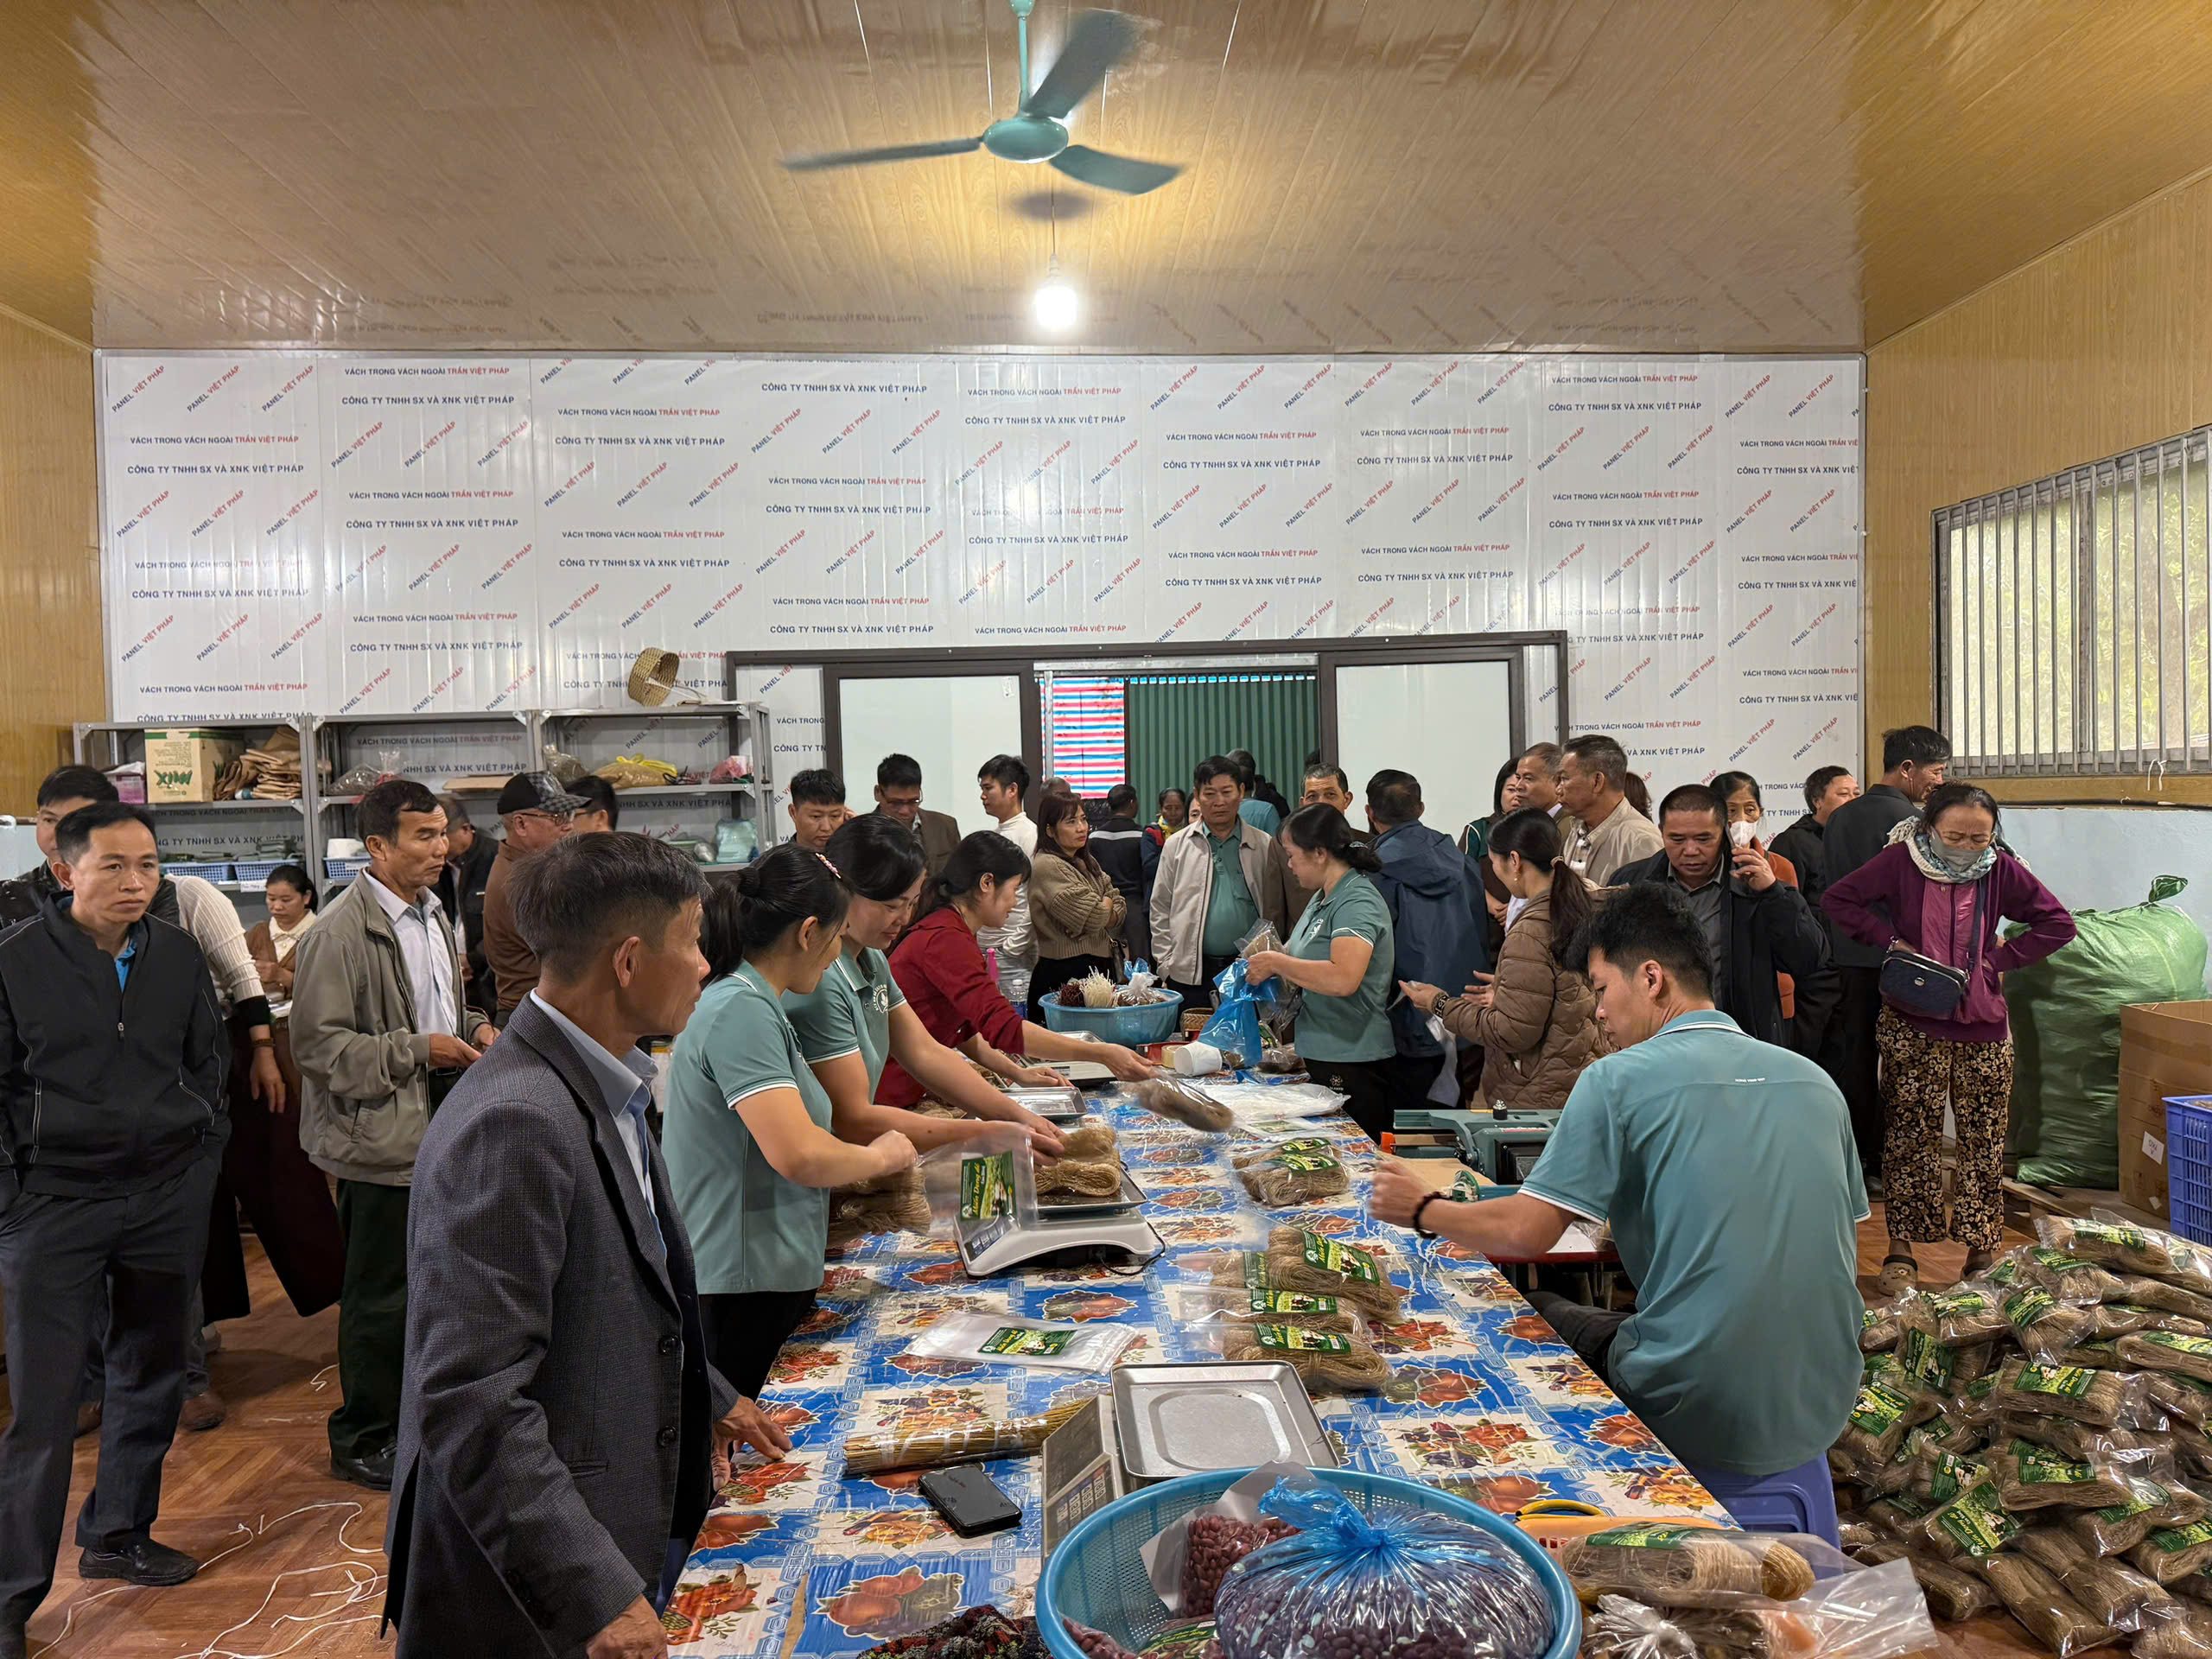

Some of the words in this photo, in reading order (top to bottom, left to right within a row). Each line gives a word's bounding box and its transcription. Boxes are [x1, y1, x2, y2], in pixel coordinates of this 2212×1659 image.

[345, 366, 365, 375] VÁCH
[421, 366, 445, 375] NGOÀI
[469, 366, 486, 375] VIỆT
[1551, 375, 1571, 384] VÁCH
[111, 394, 134, 412] PANEL
[132, 379, 147, 393] VIỆT
[147, 365, 164, 382] PHÁP
[761, 382, 787, 391] CÔNG
[843, 383, 855, 391] VÀ
[879, 384, 899, 393] VIỆT
[965, 416, 989, 424] CÔNG
[1044, 415, 1056, 423] VÀ
[1078, 415, 1098, 424] VIỆT
[1101, 415, 1125, 423] PHÁP
[331, 449, 353, 467] PANEL
[351, 435, 365, 449] VIỆT
[365, 421, 382, 438] PHÁP
[1357, 456, 1381, 465] CÔNG
[1466, 453, 1486, 463] VIỆT
[1489, 453, 1513, 461] PHÁP
[127, 464, 154, 474] CÔNG
[214, 464, 226, 473] VÀ
[252, 463, 274, 474] VIỆT
[1152, 512, 1173, 529] PANEL
[1171, 499, 1185, 512] VIỆT
[1184, 485, 1199, 500] PHÁP
[1789, 515, 1808, 532] PANEL
[1807, 502, 1820, 515] VIỆT
[1820, 489, 1834, 505] PHÁP
[346, 519, 372, 528] CÔNG
[430, 518, 442, 527] VÀ
[467, 518, 489, 527] VIỆT
[492, 518, 518, 527] PHÁP
[559, 558, 585, 567] CÔNG
[643, 558, 655, 567] VÀ
[679, 558, 701, 568] VIỆT
[1242, 576, 1253, 585] VÀ
[1275, 575, 1295, 585] VIỆT
[1298, 575, 1321, 584] PHÁP
[1604, 683, 1624, 701] PANEL
[1623, 671, 1636, 683] VIỆT
[1635, 657, 1650, 673] PHÁP
